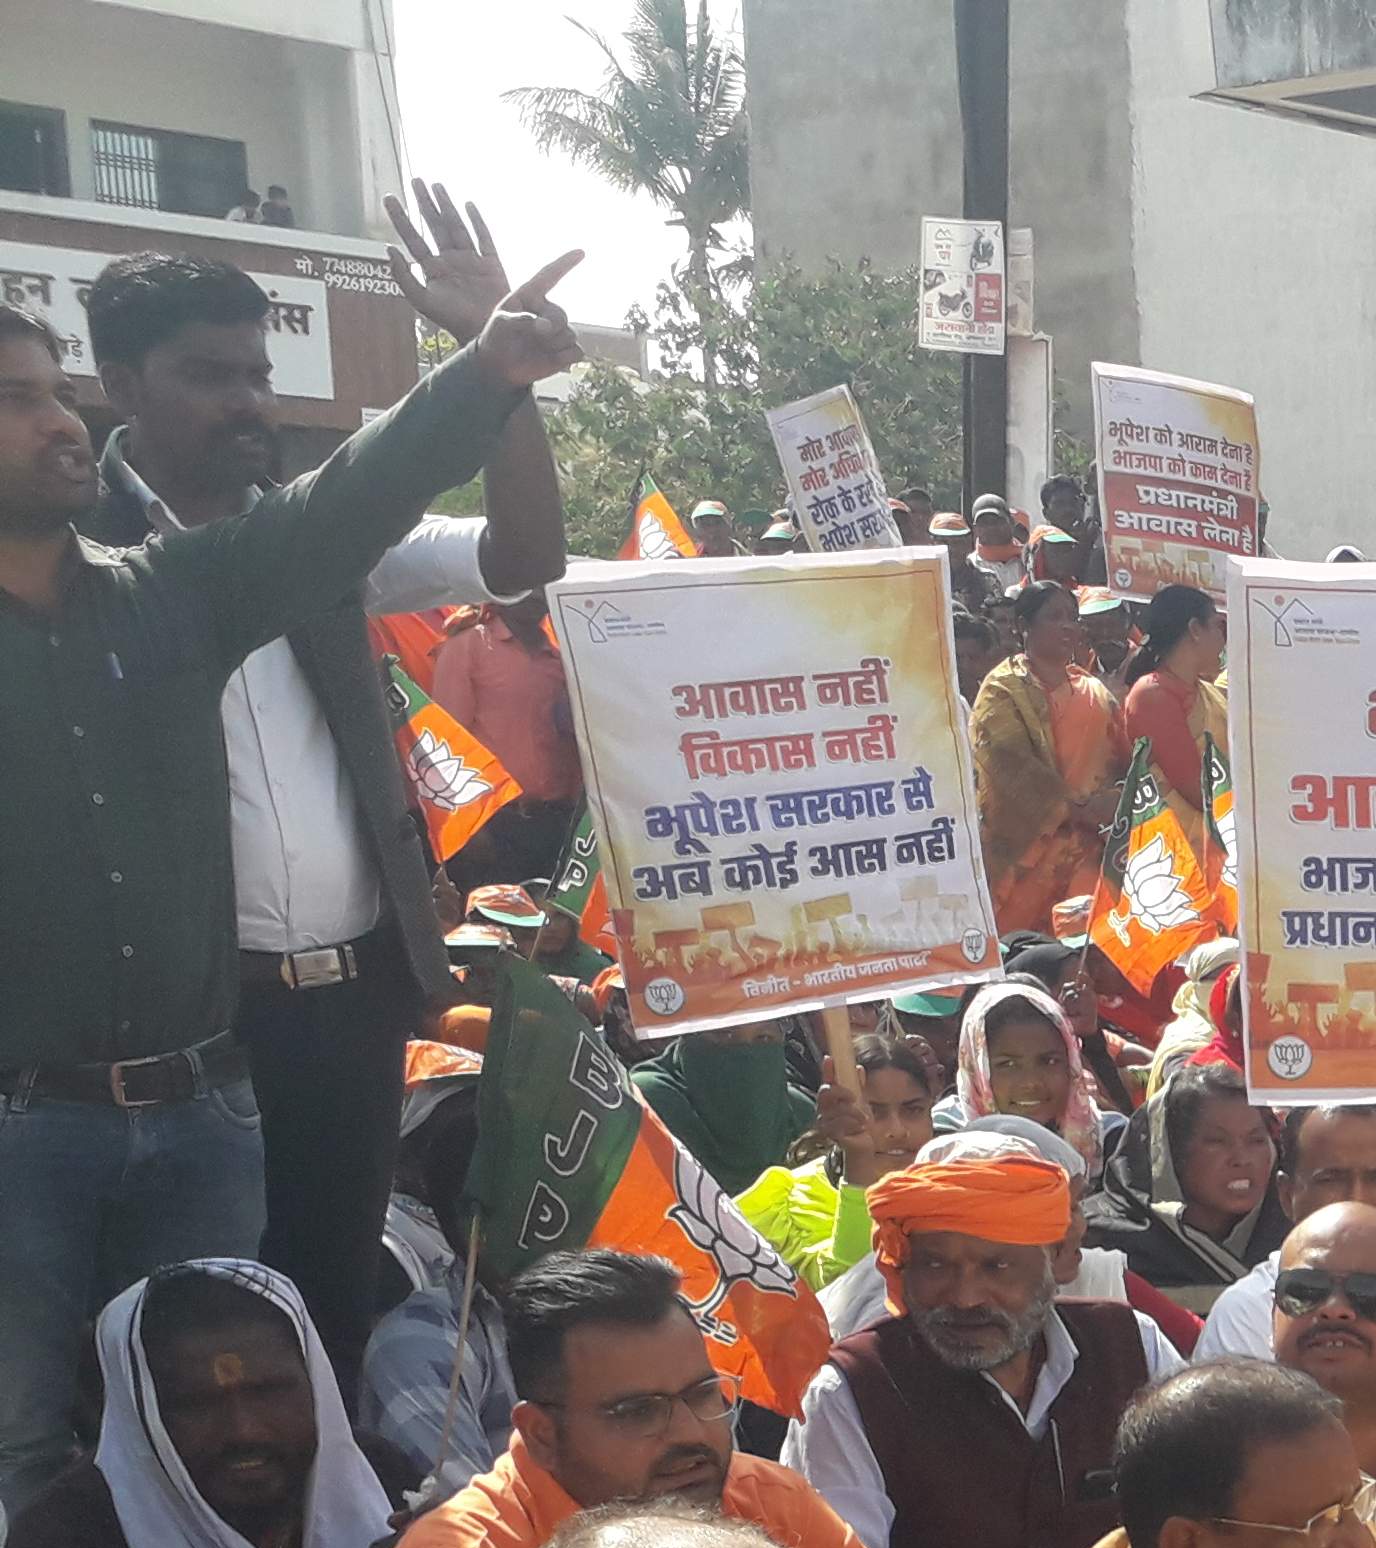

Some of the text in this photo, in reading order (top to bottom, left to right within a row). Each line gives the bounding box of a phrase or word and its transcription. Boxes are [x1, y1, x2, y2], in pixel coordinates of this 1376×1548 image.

[324, 272, 405, 297] 992619230
[1109, 418, 1150, 447] भूपेश
[1152, 424, 1173, 447] को
[1177, 431, 1219, 456] आराम
[1221, 436, 1245, 460] देना
[1112, 449, 1163, 473] भाजपा
[1167, 454, 1187, 477] को
[1189, 463, 1218, 483] काम
[1220, 465, 1243, 489] देना
[1135, 484, 1239, 520] प्रधानमंत्री
[1114, 509, 1254, 554] आवास लेना है
[672, 656, 892, 721] आवास नहीं
[680, 714, 900, 781] विकास नहीं
[643, 766, 935, 855] भूपेश सरकार से
[632, 817, 957, 901] अब कोई आस नहीं
[803, 961, 857, 987] भारतीय
[858, 956, 899, 977] जनता
[518, 1031, 624, 1249] BJP
